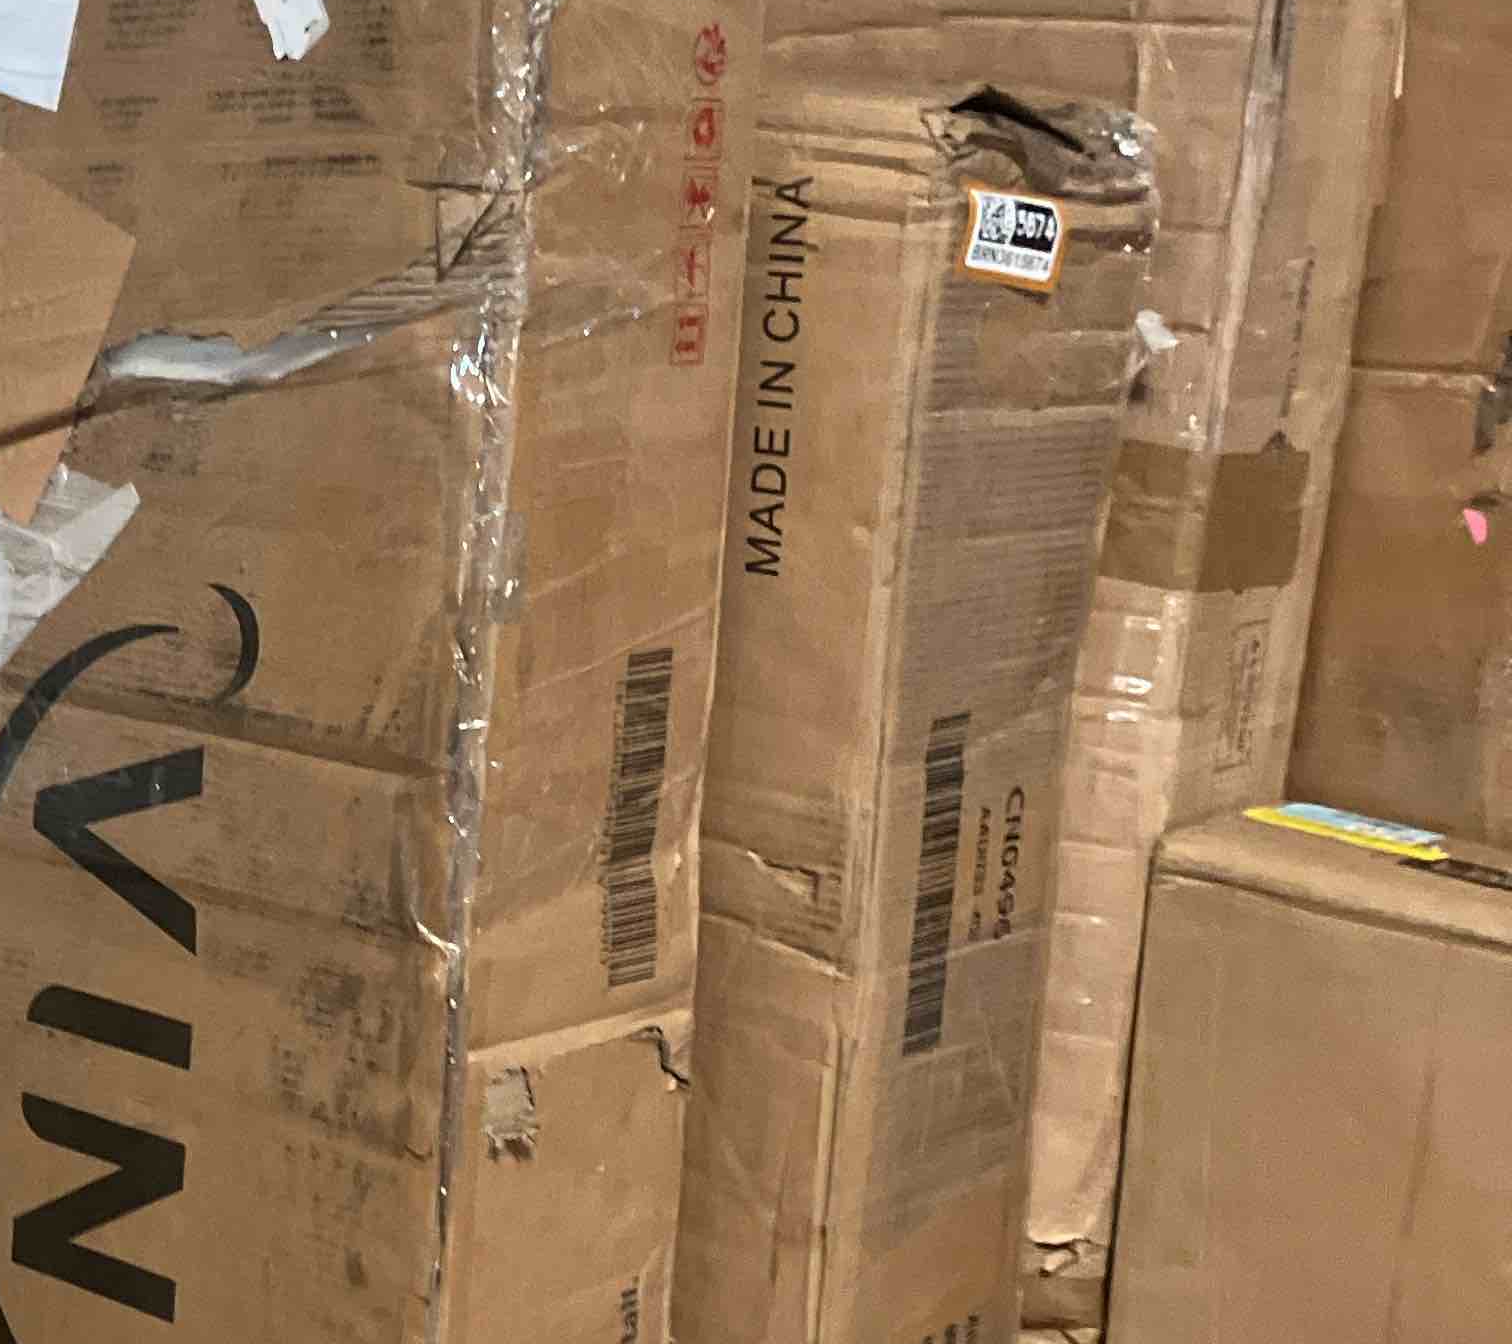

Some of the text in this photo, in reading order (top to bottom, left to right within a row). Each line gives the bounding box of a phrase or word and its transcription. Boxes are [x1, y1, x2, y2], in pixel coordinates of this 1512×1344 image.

[744, 175, 814, 577] MADE IN CHINA
